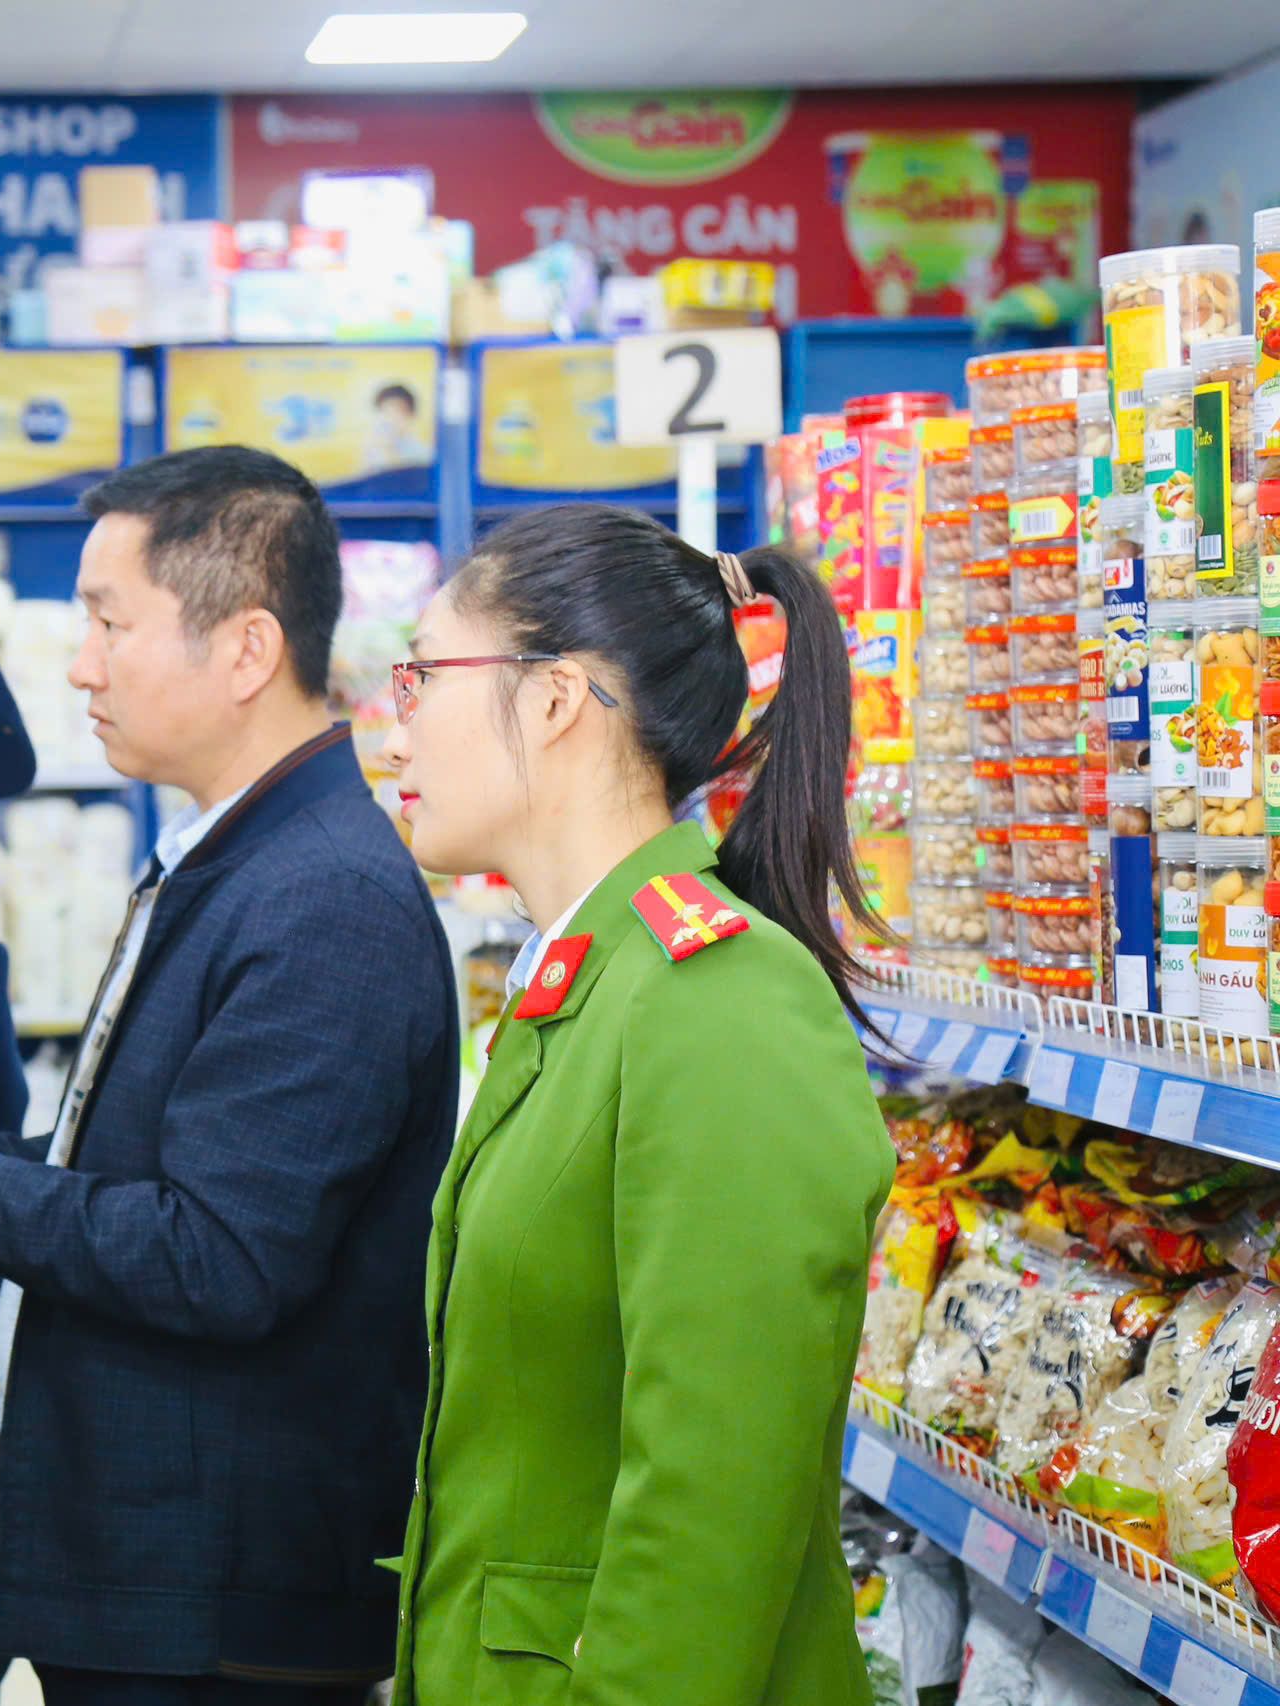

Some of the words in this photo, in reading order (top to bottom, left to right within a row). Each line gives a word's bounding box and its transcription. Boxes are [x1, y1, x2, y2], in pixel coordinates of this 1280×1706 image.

[683, 193, 798, 256] CÂN
[663, 343, 726, 436] 2
[1219, 969, 1254, 989] GẤU
